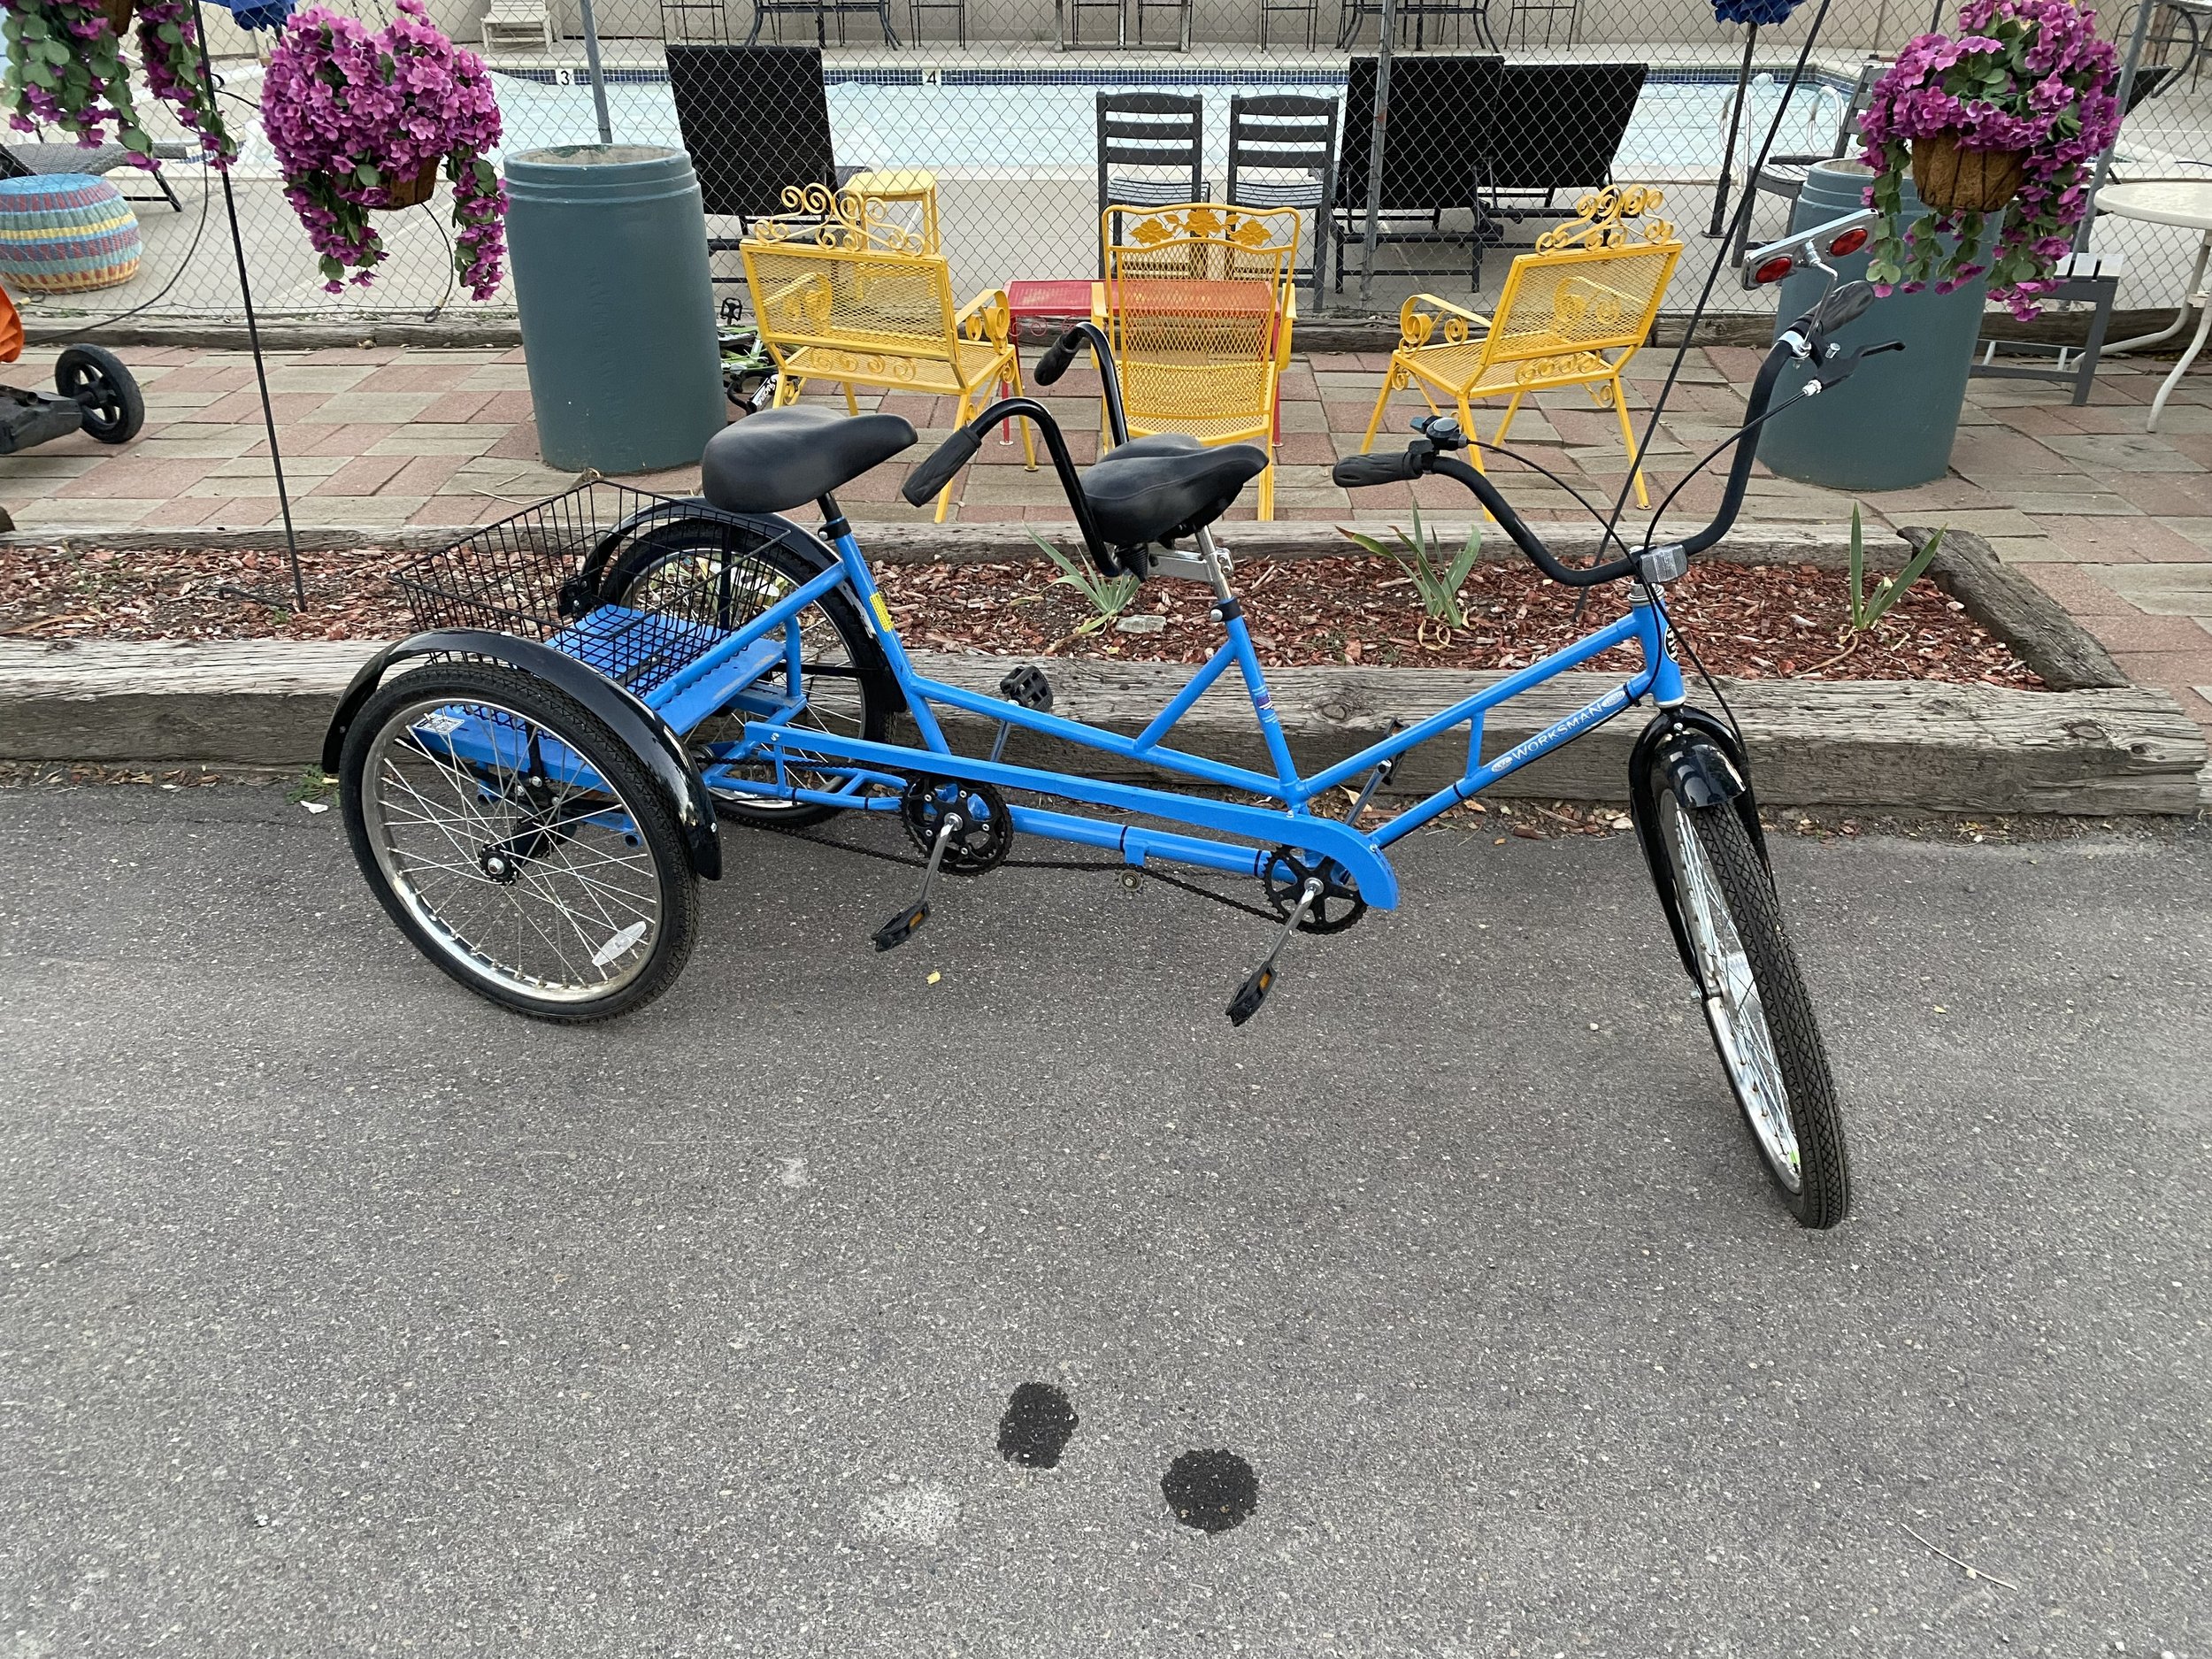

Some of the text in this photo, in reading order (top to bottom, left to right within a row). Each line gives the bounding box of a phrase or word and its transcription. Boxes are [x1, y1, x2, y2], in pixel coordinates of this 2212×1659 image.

[561, 70, 570, 86] 3
[926, 70, 937, 86] 4
[1511, 702, 1603, 760] WORKSMAN
